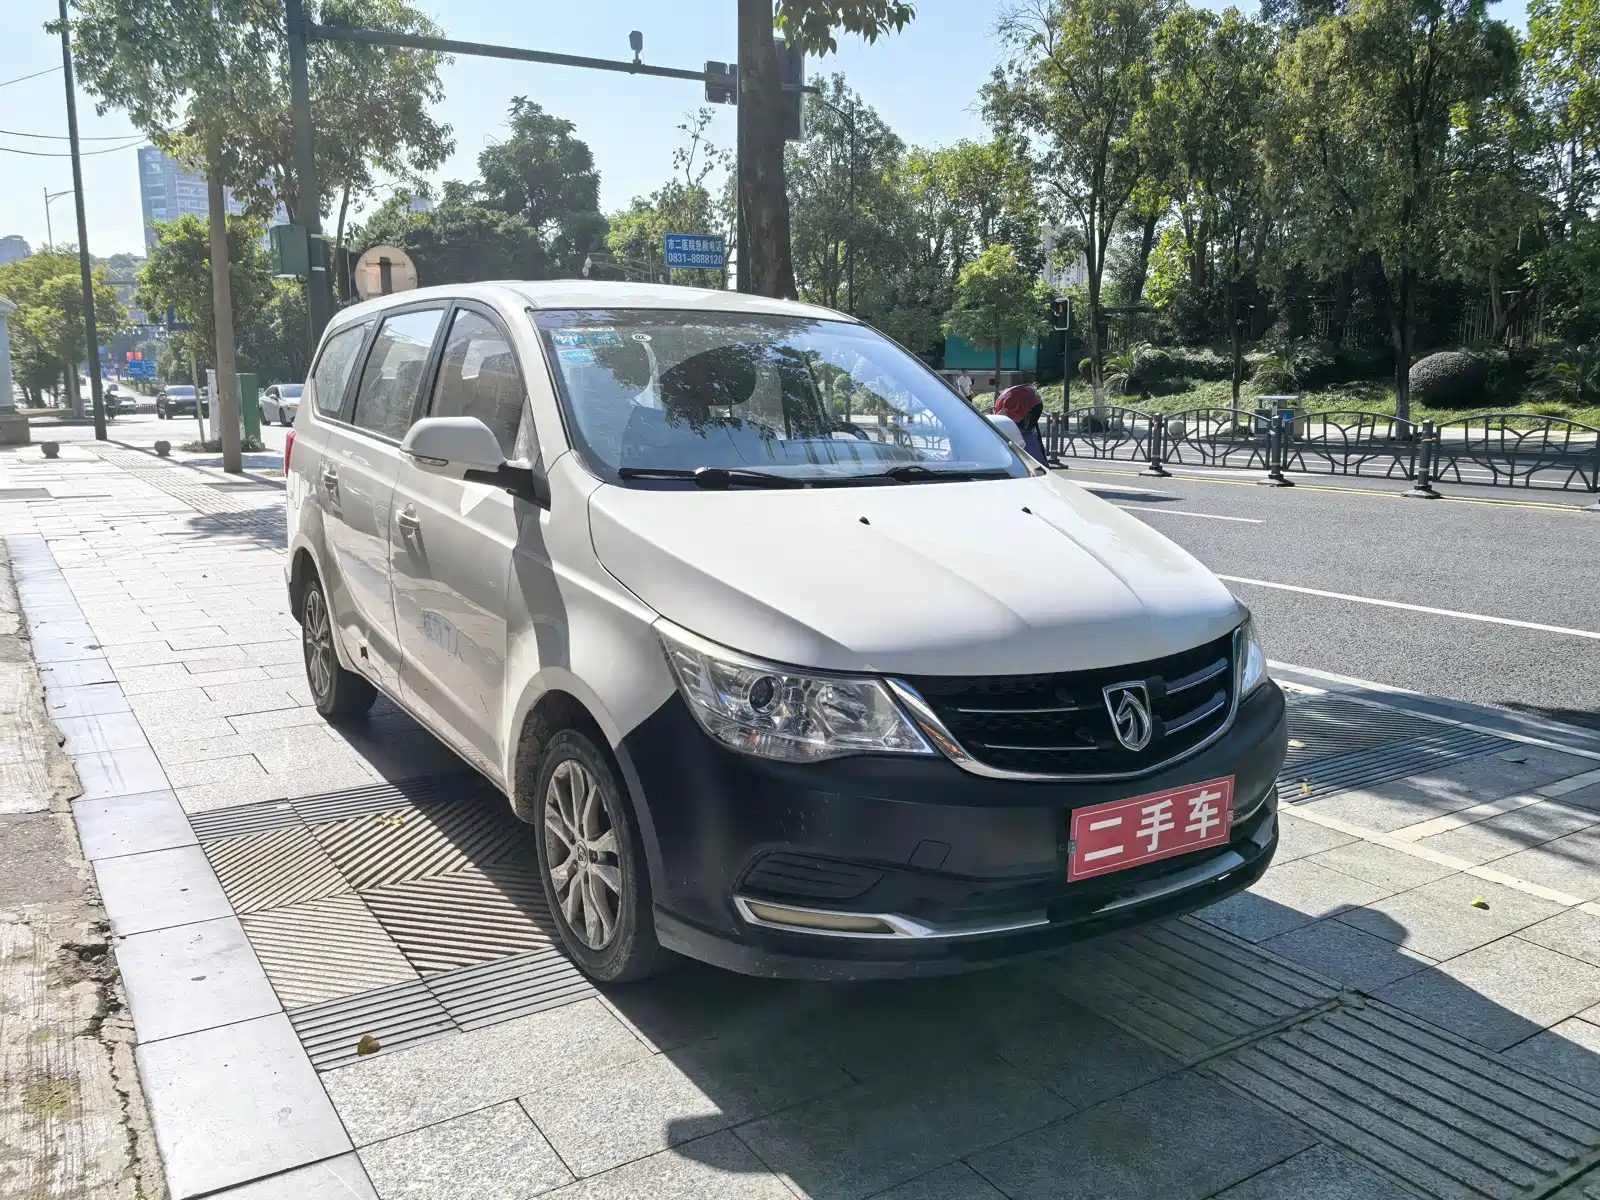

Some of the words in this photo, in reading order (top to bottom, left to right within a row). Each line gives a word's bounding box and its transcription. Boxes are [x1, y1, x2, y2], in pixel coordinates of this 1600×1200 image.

[668, 239, 722, 253] 市二医院急救电话
[668, 253, 723, 265] 0831-8888120
[1084, 790, 1222, 862] 二手车
